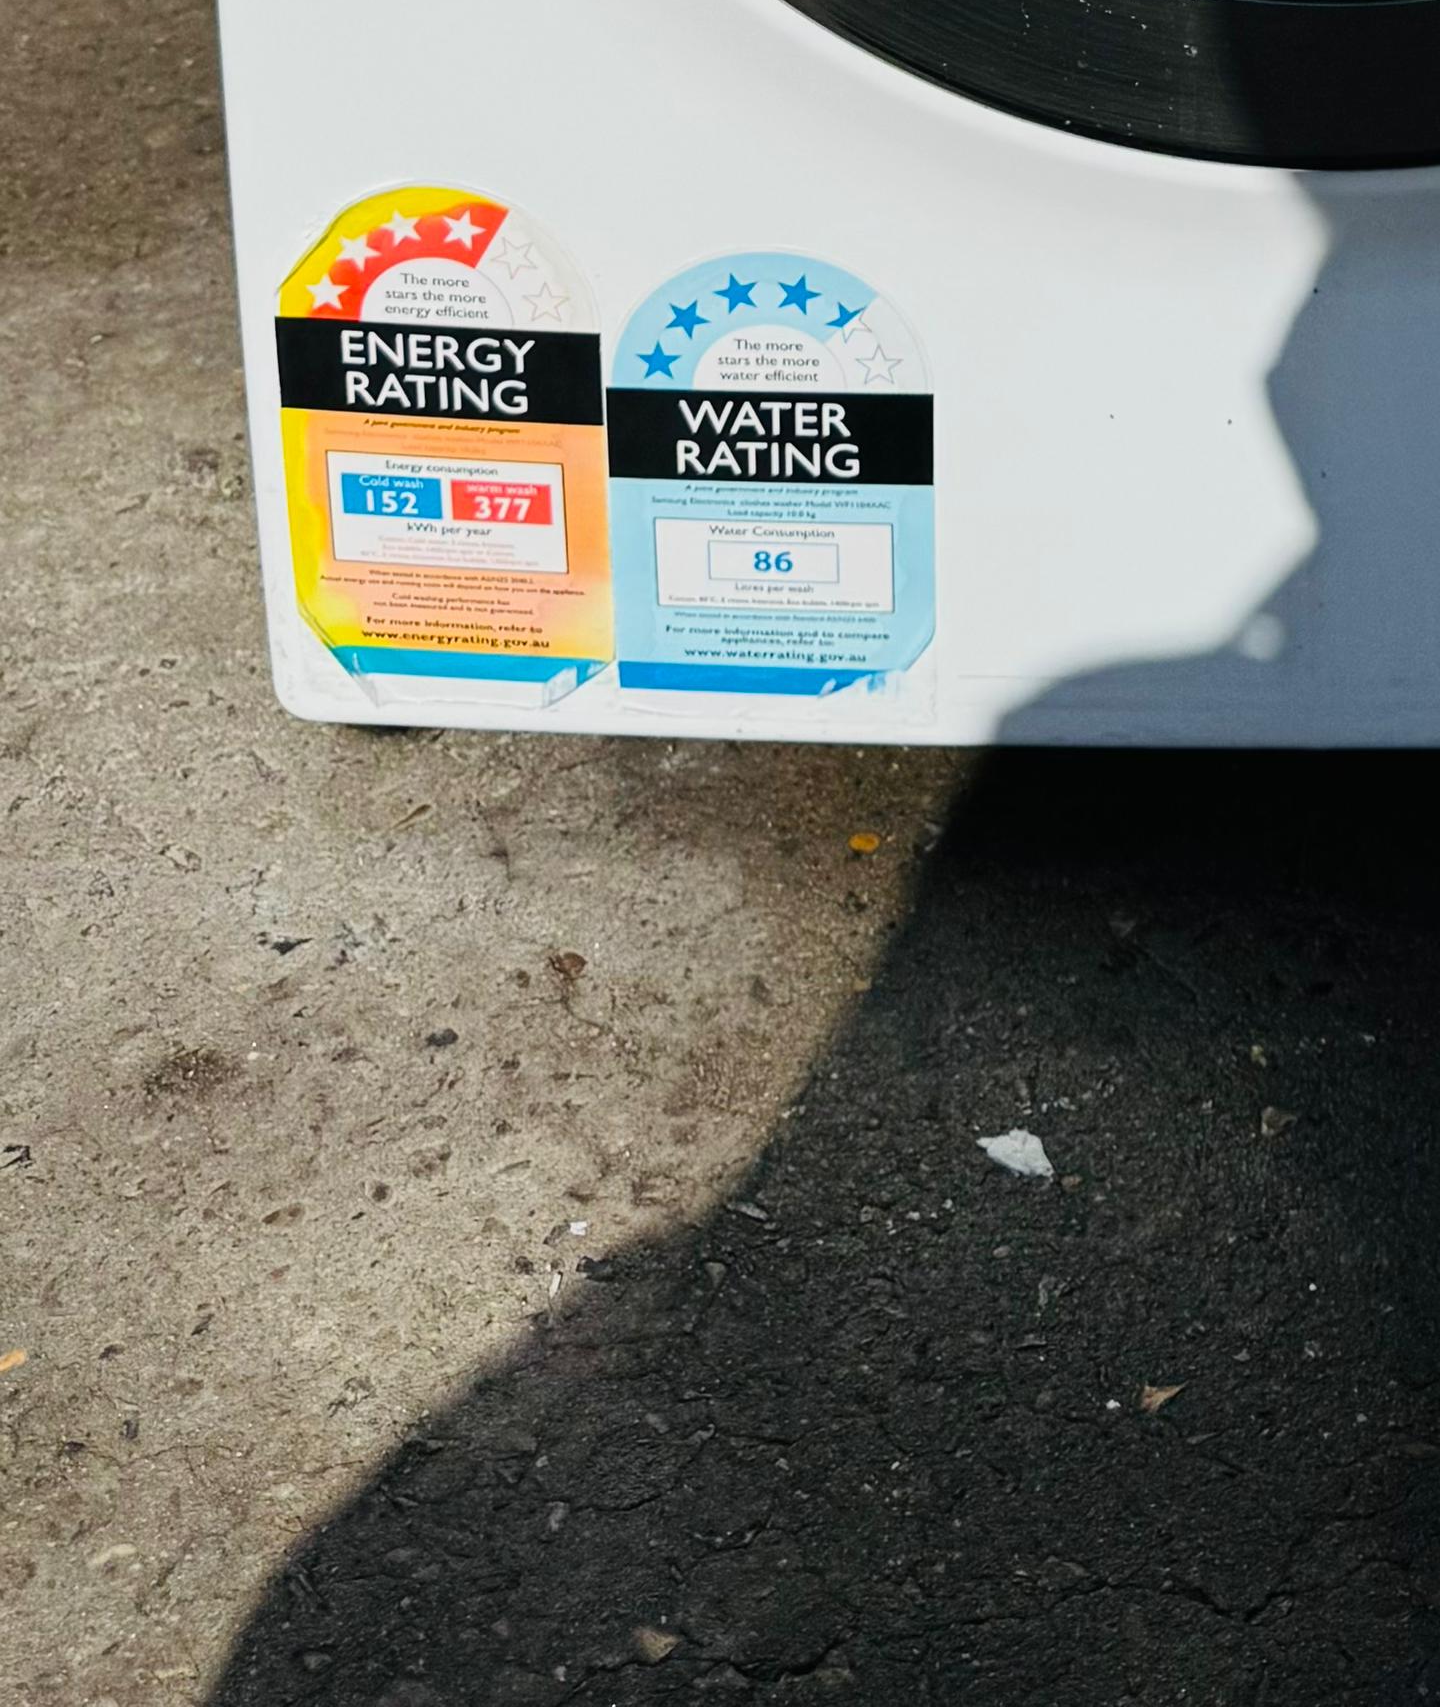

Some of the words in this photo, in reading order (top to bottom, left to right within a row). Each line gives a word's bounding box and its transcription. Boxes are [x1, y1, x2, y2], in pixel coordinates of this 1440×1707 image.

[400, 272, 428, 286] The
[432, 276, 470, 288] more
[385, 290, 418, 300] stars
[422, 290, 445, 302] the
[449, 293, 487, 304] more
[384, 305, 431, 319] energy
[435, 306, 489, 319] efficient
[340, 330, 536, 375] ENERGY
[734, 338, 761, 350] The
[766, 342, 804, 351] more
[718, 356, 751, 366] stars
[755, 354, 778, 366] the
[782, 358, 820, 367] more
[720, 371, 760, 381] water
[765, 370, 819, 382] efficient
[345, 371, 529, 416] RATING
[678, 399, 852, 438] WATER
[676, 439, 861, 478] RATING
[385, 459, 423, 474] Energy
[426, 463, 499, 477] consumption
[358, 474, 390, 487] Cold
[392, 477, 424, 490] wash
[366, 489, 419, 515] 152
[473, 496, 532, 522] 377
[406, 522, 438, 534] kWh
[441, 525, 461, 536] per
[466, 526, 493, 537] year
[709, 525, 748, 537] Water
[752, 525, 836, 540] Consumption
[753, 550, 793, 573] 86
[366, 616, 386, 625] For
[389, 619, 421, 627] more
[498, 625, 526, 633] refer
[529, 626, 543, 634] to
